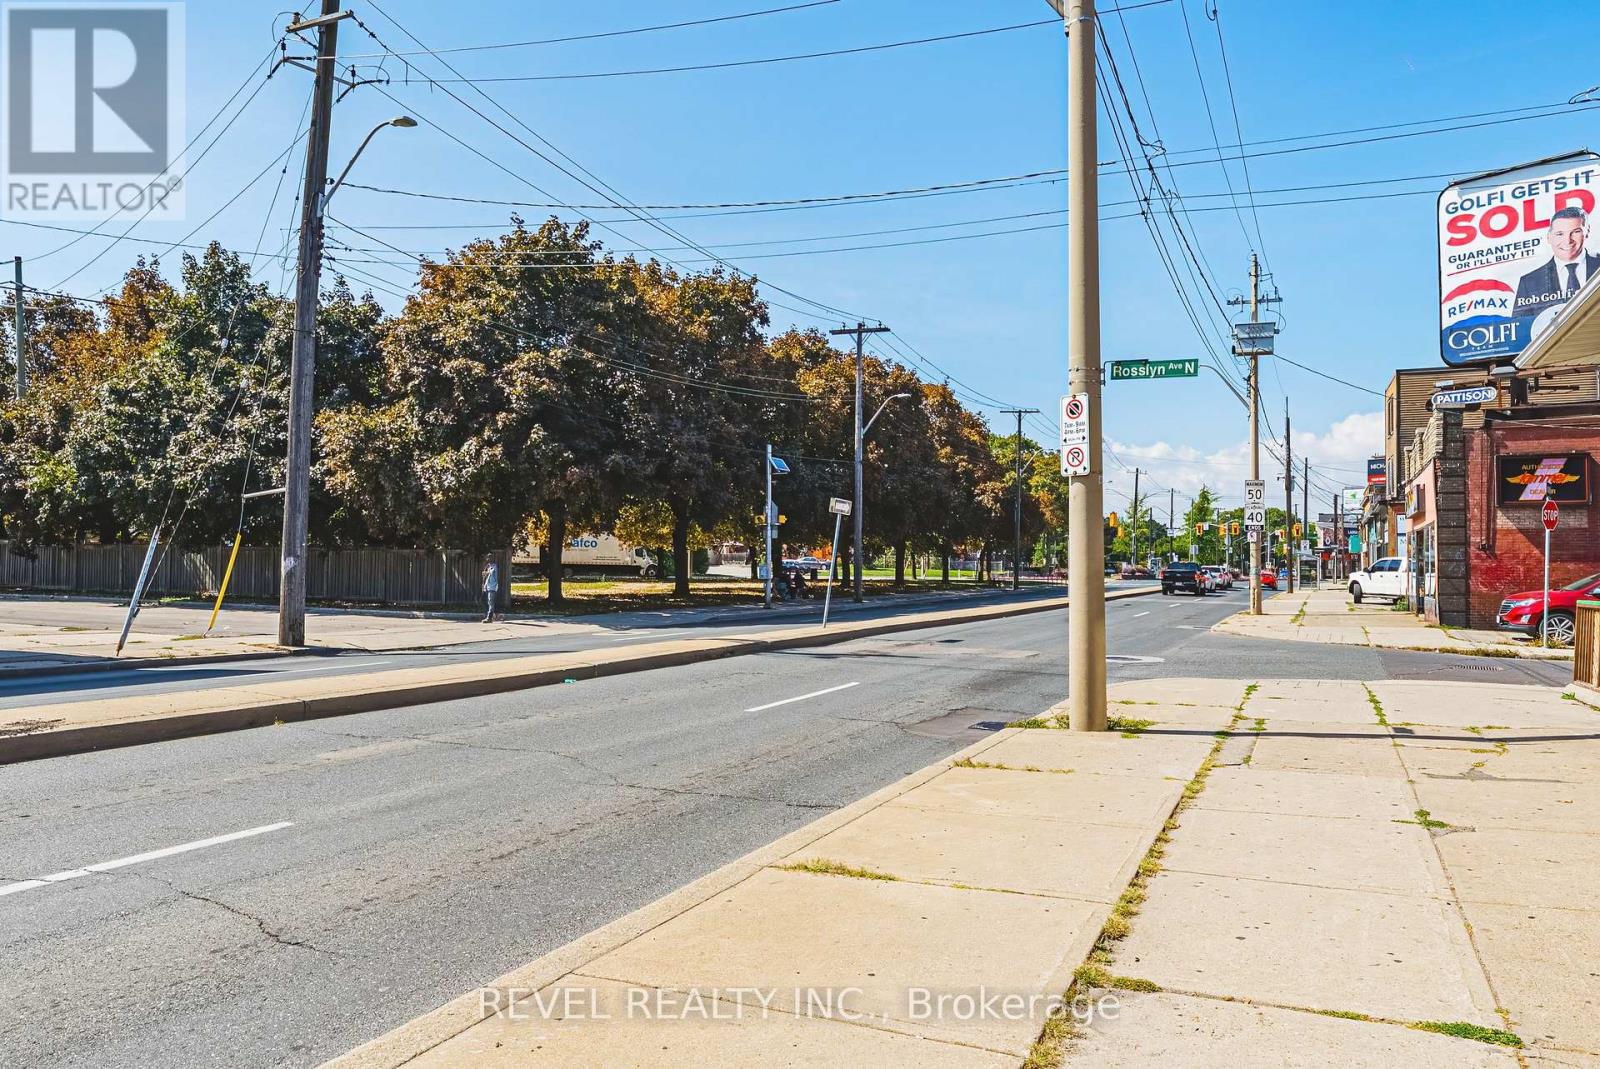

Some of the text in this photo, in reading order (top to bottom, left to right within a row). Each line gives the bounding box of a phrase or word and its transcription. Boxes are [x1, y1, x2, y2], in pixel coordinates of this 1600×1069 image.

[1445, 169, 1594, 215] GOLFI GETS IT
[1446, 188, 1596, 247] SOLD
[1448, 238, 1541, 264] GUARANTEED
[1456, 249, 1535, 270] OR I'LL BUY IT!
[1448, 297, 1508, 318] RE/MAX
[1517, 294, 1540, 307] Rob
[1448, 323, 1518, 349] GOLFI
[1112, 363, 1166, 378] Rosslyn
[1184, 361, 1195, 374] N
[1436, 390, 1491, 403] PATTISON
[1247, 489, 1262, 500] 50
[1246, 511, 1263, 523] 40
[1543, 509, 1559, 520] STOP
